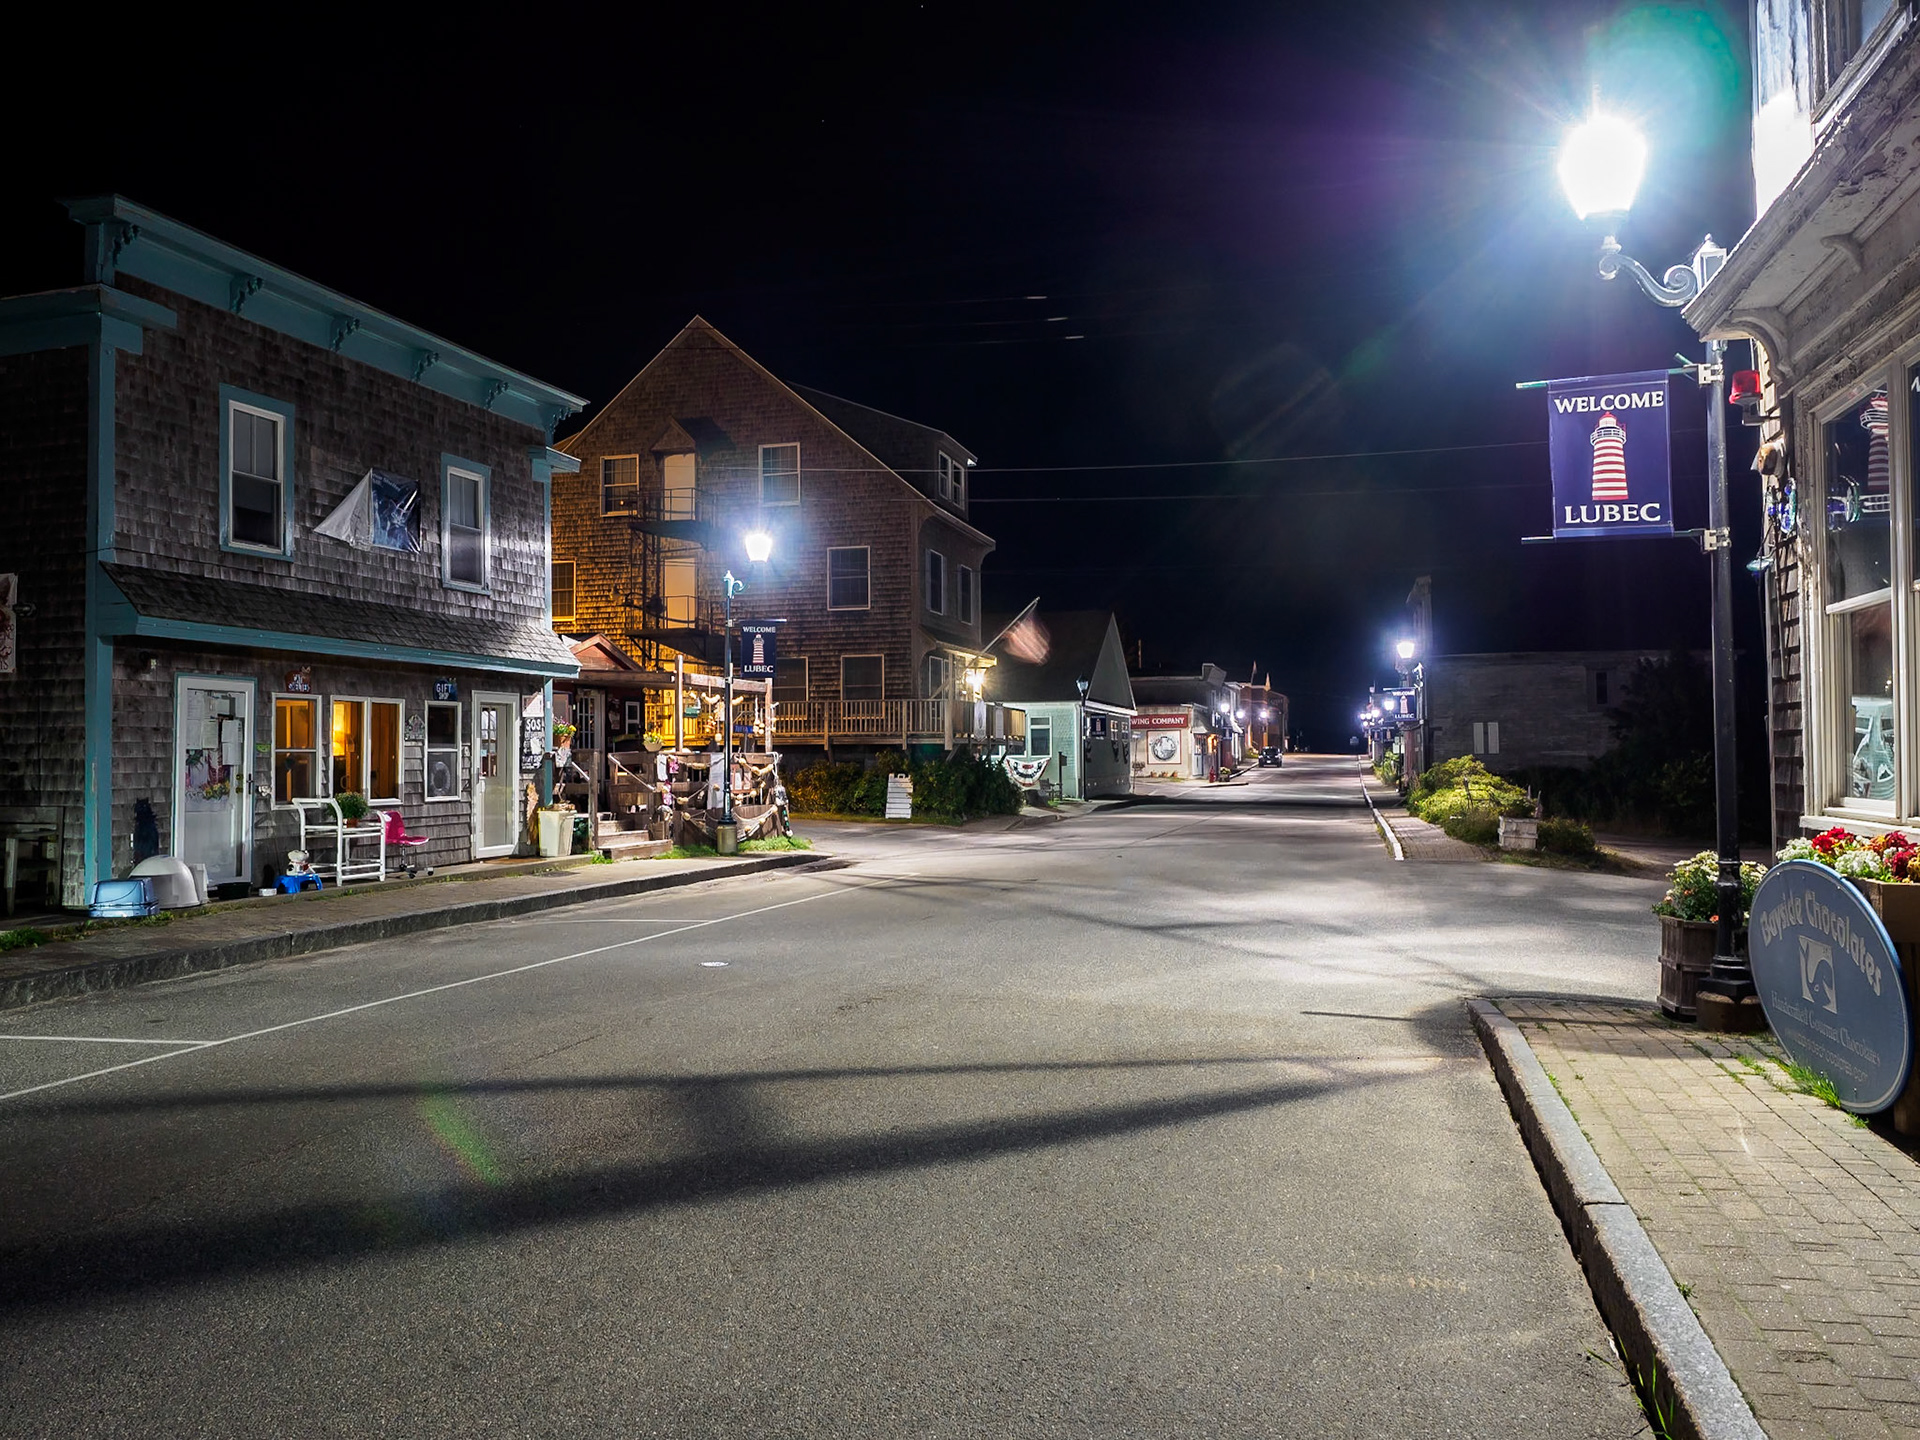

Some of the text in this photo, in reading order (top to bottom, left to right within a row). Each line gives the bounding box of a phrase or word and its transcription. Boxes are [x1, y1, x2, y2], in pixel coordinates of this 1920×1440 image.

[1553, 390, 1665, 414] WELCOME
[1564, 502, 1662, 524] LUBEC
[743, 664, 774, 673] LUBEC
[436, 683, 453, 693] GIFT
[525, 718, 541, 731] SOS
[1151, 717, 1185, 725] COMPANY
[1760, 890, 1882, 997] Bayside Chocolates
